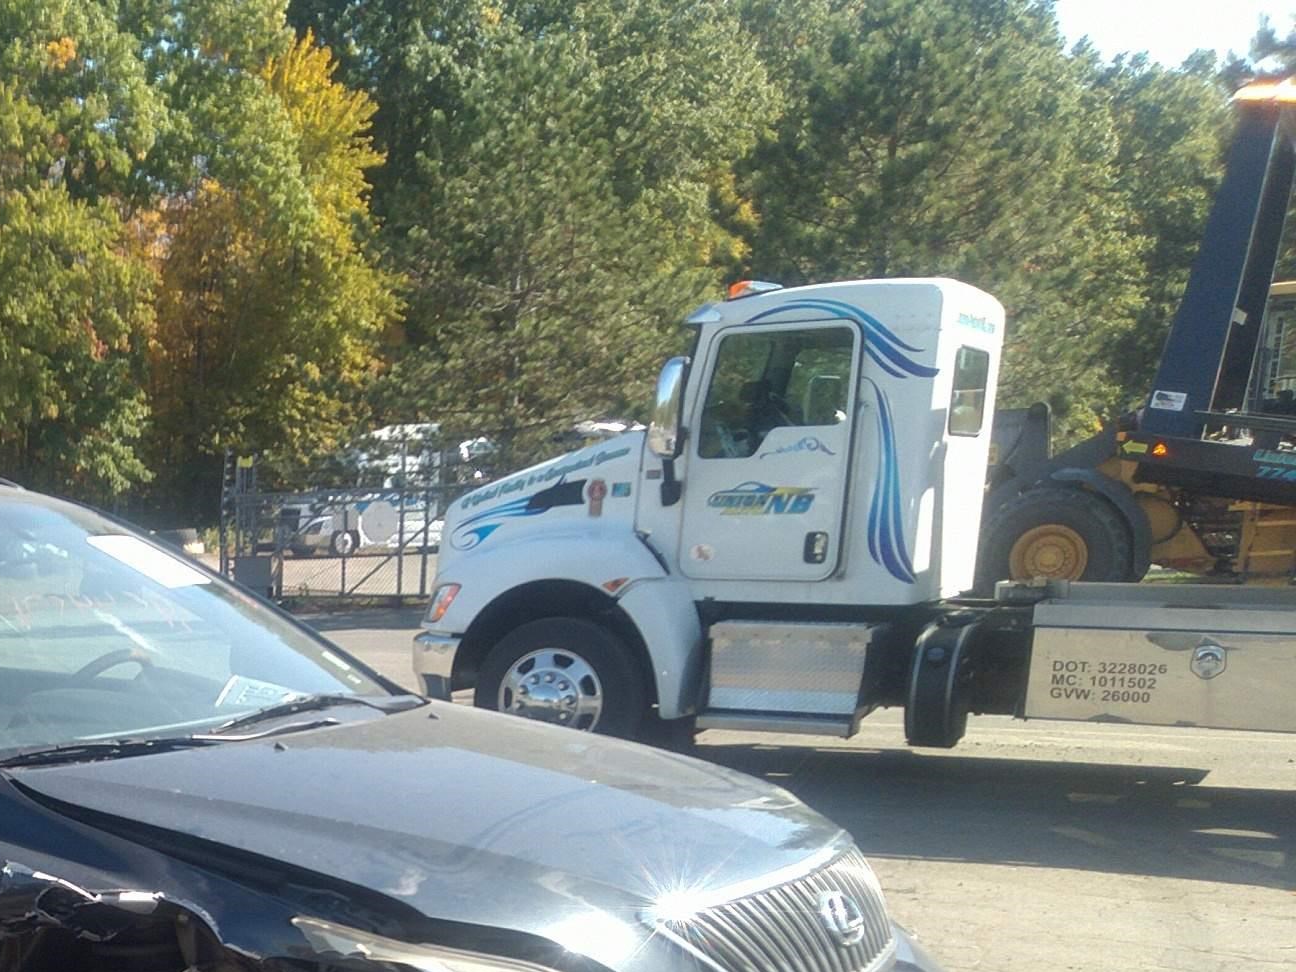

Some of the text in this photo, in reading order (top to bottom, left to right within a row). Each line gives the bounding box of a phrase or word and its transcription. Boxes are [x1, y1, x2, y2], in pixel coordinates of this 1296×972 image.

[1052, 660, 1168, 675] DOT: 3228026
[1051, 674, 1157, 689] MC: 1011502
[1050, 687, 1151, 703] GVW: 26000
